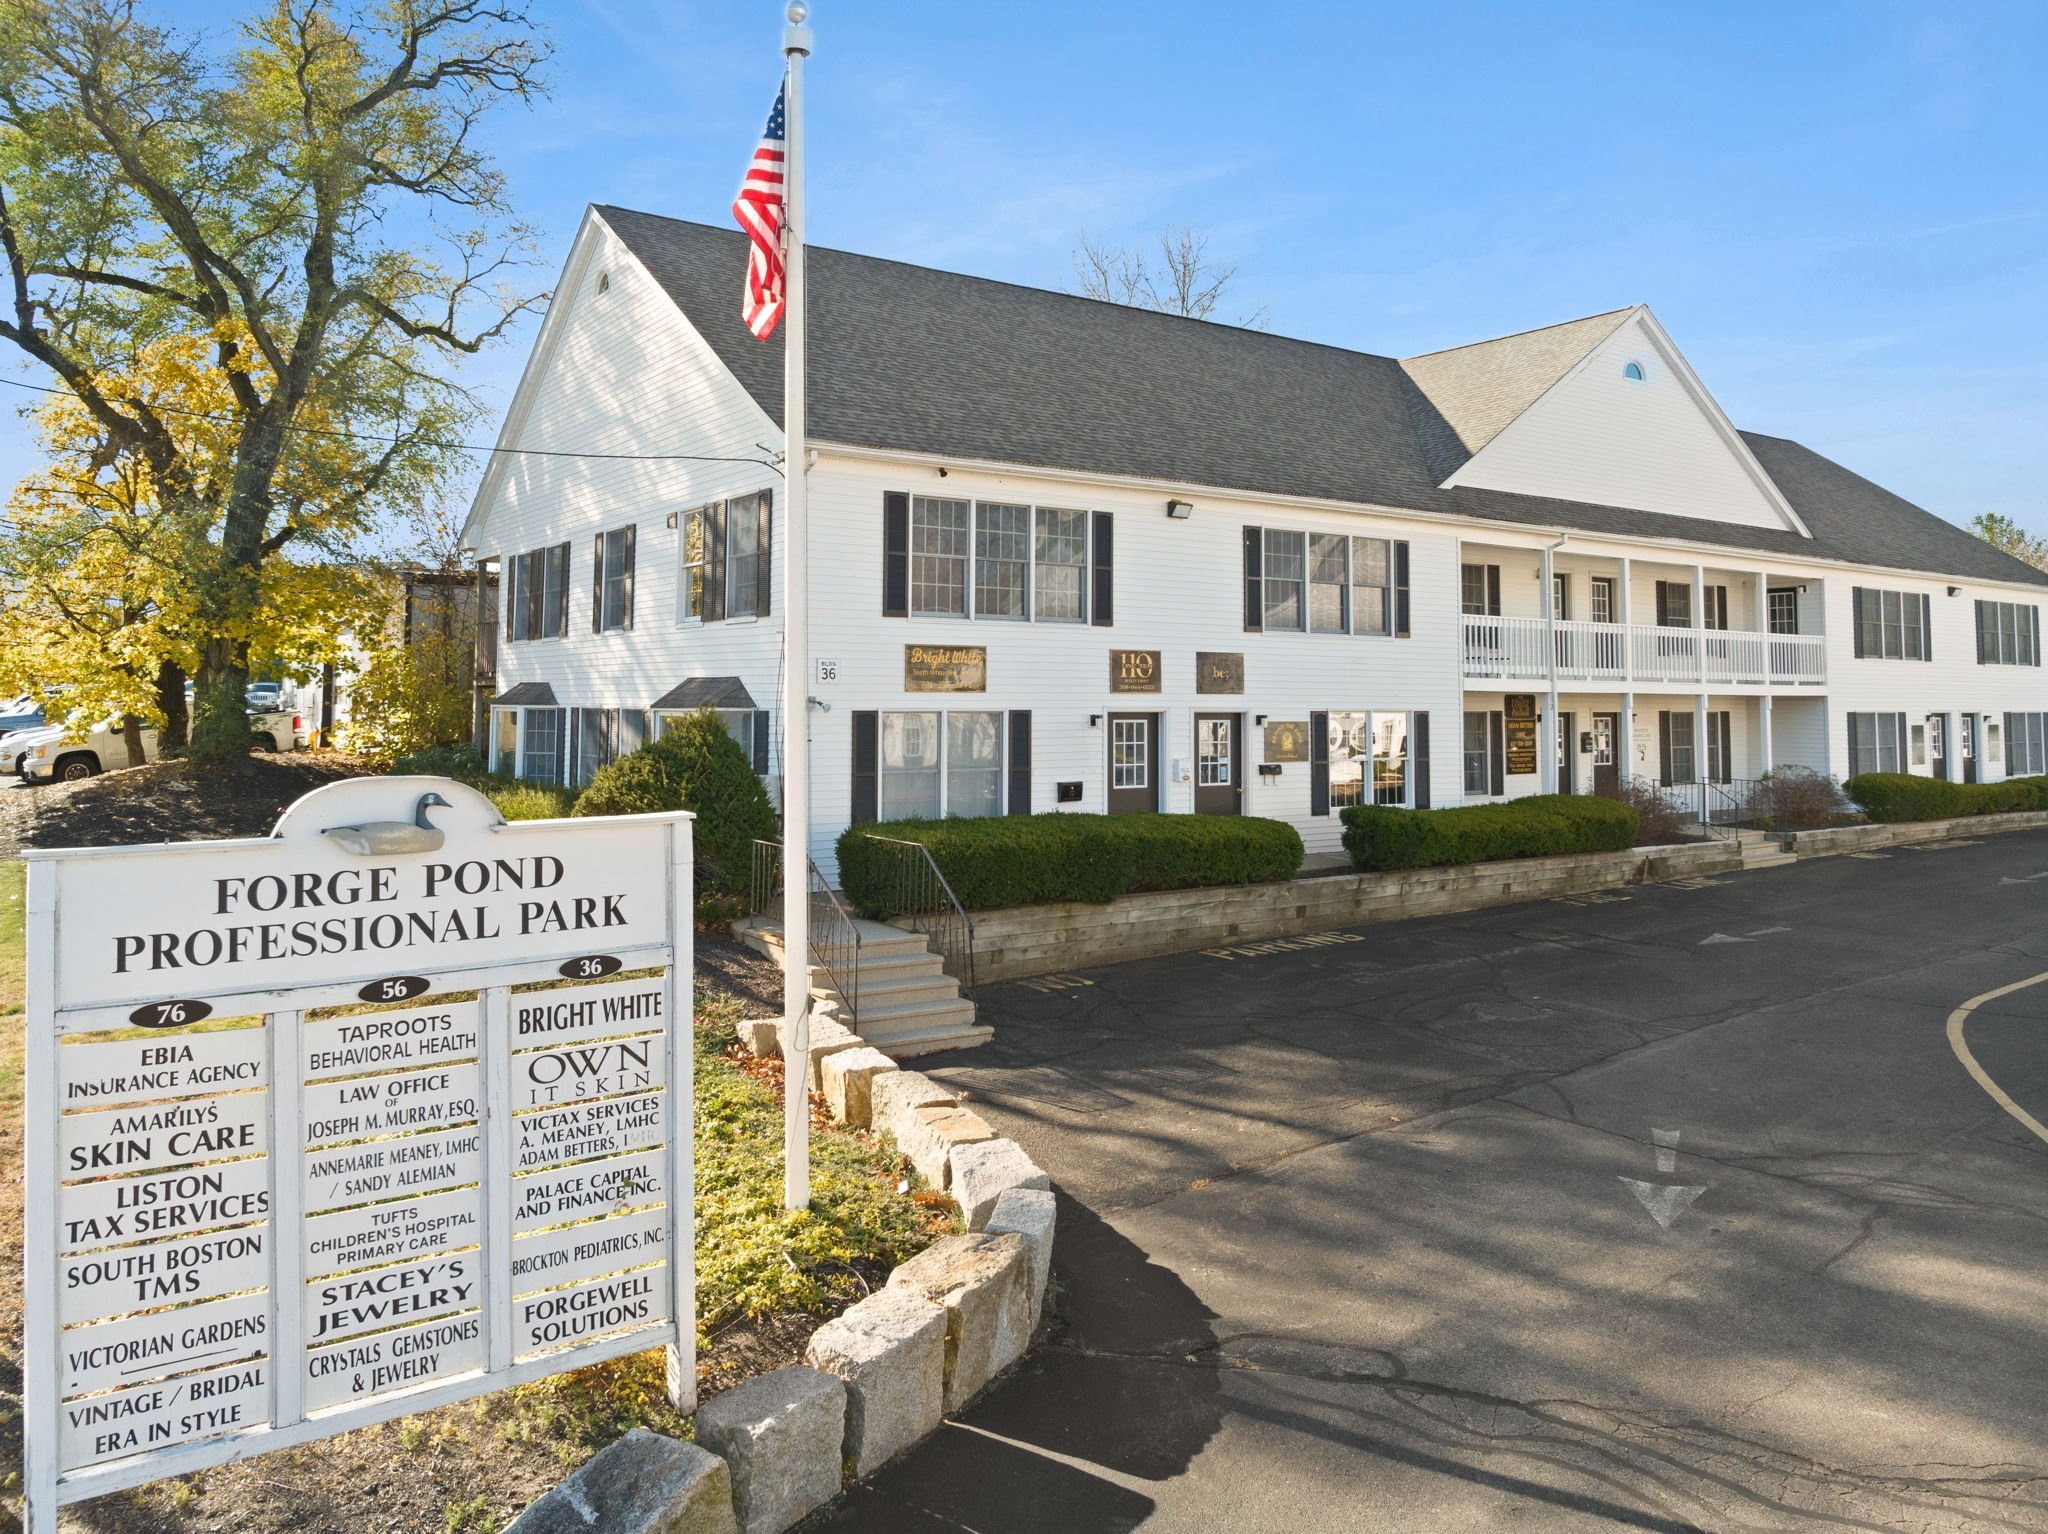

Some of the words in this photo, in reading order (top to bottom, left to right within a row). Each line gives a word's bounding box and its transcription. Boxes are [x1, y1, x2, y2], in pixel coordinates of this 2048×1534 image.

[821, 667, 836, 680] 36
[911, 648, 951, 669] Bright
[951, 649, 983, 665] White
[1213, 666, 1229, 679] be;
[214, 868, 398, 914] FORGE
[424, 856, 563, 897] POND
[112, 907, 500, 976] PROFESSIONAL
[519, 895, 628, 935] PARK
[1200, 931, 1367, 961] PARKING
[580, 959, 602, 975] 36
[382, 979, 407, 999] 56
[157, 1003, 185, 1024] 76
[338, 1015, 451, 1043] TAPROOTS
[519, 1001, 597, 1034] BRIGHT
[602, 992, 661, 1022] WHITE
[142, 1046, 193, 1066] EBIA
[311, 1042, 412, 1070] BEHAVIORAL
[420, 1033, 475, 1055] HEALTH
[529, 1039, 651, 1087] OWN
[69, 1071, 178, 1098] INSURANCE
[187, 1062, 260, 1084] AGENCY
[340, 1085, 379, 1103] LAW
[388, 1075, 448, 1096] OFFICE
[531, 1086, 558, 1104] IT
[576, 1071, 652, 1097] SKIN
[385, 1099, 398, 1107] OF
[521, 1111, 579, 1132] VICTAX
[587, 1097, 659, 1124] SERVICES
[308, 1117, 359, 1142] JOSEPH
[365, 1114, 381, 1129] M.
[520, 1136, 534, 1149] A.
[542, 1122, 609, 1145] MEANEY,
[617, 1112, 659, 1131] LMHC
[70, 1138, 150, 1172] SKIN
[168, 1124, 254, 1156] CARE
[310, 1152, 383, 1178] ANNEMARIE
[390, 1144, 442, 1164] MEANEY,
[447, 1136, 479, 1155] LMHC
[519, 1147, 558, 1166] ADAM
[565, 1137, 621, 1161] BETTERS,
[118, 1172, 222, 1208] LISTON
[346, 1174, 391, 1195] SANDY
[397, 1163, 455, 1188] ALEMIAN
[527, 1178, 583, 1201] PALACE
[591, 1166, 649, 1188] CAPITAL
[65, 1214, 124, 1243] TAX
[135, 1191, 268, 1233] SERVICES
[372, 1208, 417, 1225] TUFTS
[515, 1201, 550, 1220] AND
[558, 1186, 625, 1211] FINANCE
[631, 1179, 661, 1196] INC.
[311, 1227, 400, 1255] CHILDREN'S
[406, 1213, 475, 1235] HOSPITAL
[338, 1241, 405, 1264] PRIMARY
[410, 1233, 447, 1249] CARE
[510, 1250, 568, 1276] BROCKTON
[575, 1233, 641, 1261] PEDIATRICS,
[644, 1228, 664, 1245] INC.
[68, 1251, 154, 1288] SOUTH
[166, 1235, 261, 1270] BOSTON
[134, 1270, 200, 1301] TMS
[322, 1261, 463, 1307] STACEY'S
[525, 1277, 652, 1325] FORGEWELL
[313, 1280, 472, 1340] JEWELRY
[532, 1297, 648, 1346] SOLUTIONS
[70, 1334, 173, 1372] VICTORIAN
[182, 1315, 265, 1349] GARDENS
[307, 1340, 380, 1377] CRYSTALS
[393, 1320, 478, 1357] GEMSTONES
[352, 1373, 364, 1392] &
[371, 1353, 439, 1392] JEWELRY
[69, 1391, 162, 1428] VINTAGE
[191, 1368, 264, 1401] BRIDAL
[96, 1429, 138, 1455] ERA
[149, 1420, 170, 1442] IN
[181, 1405, 240, 1436] STYLE
